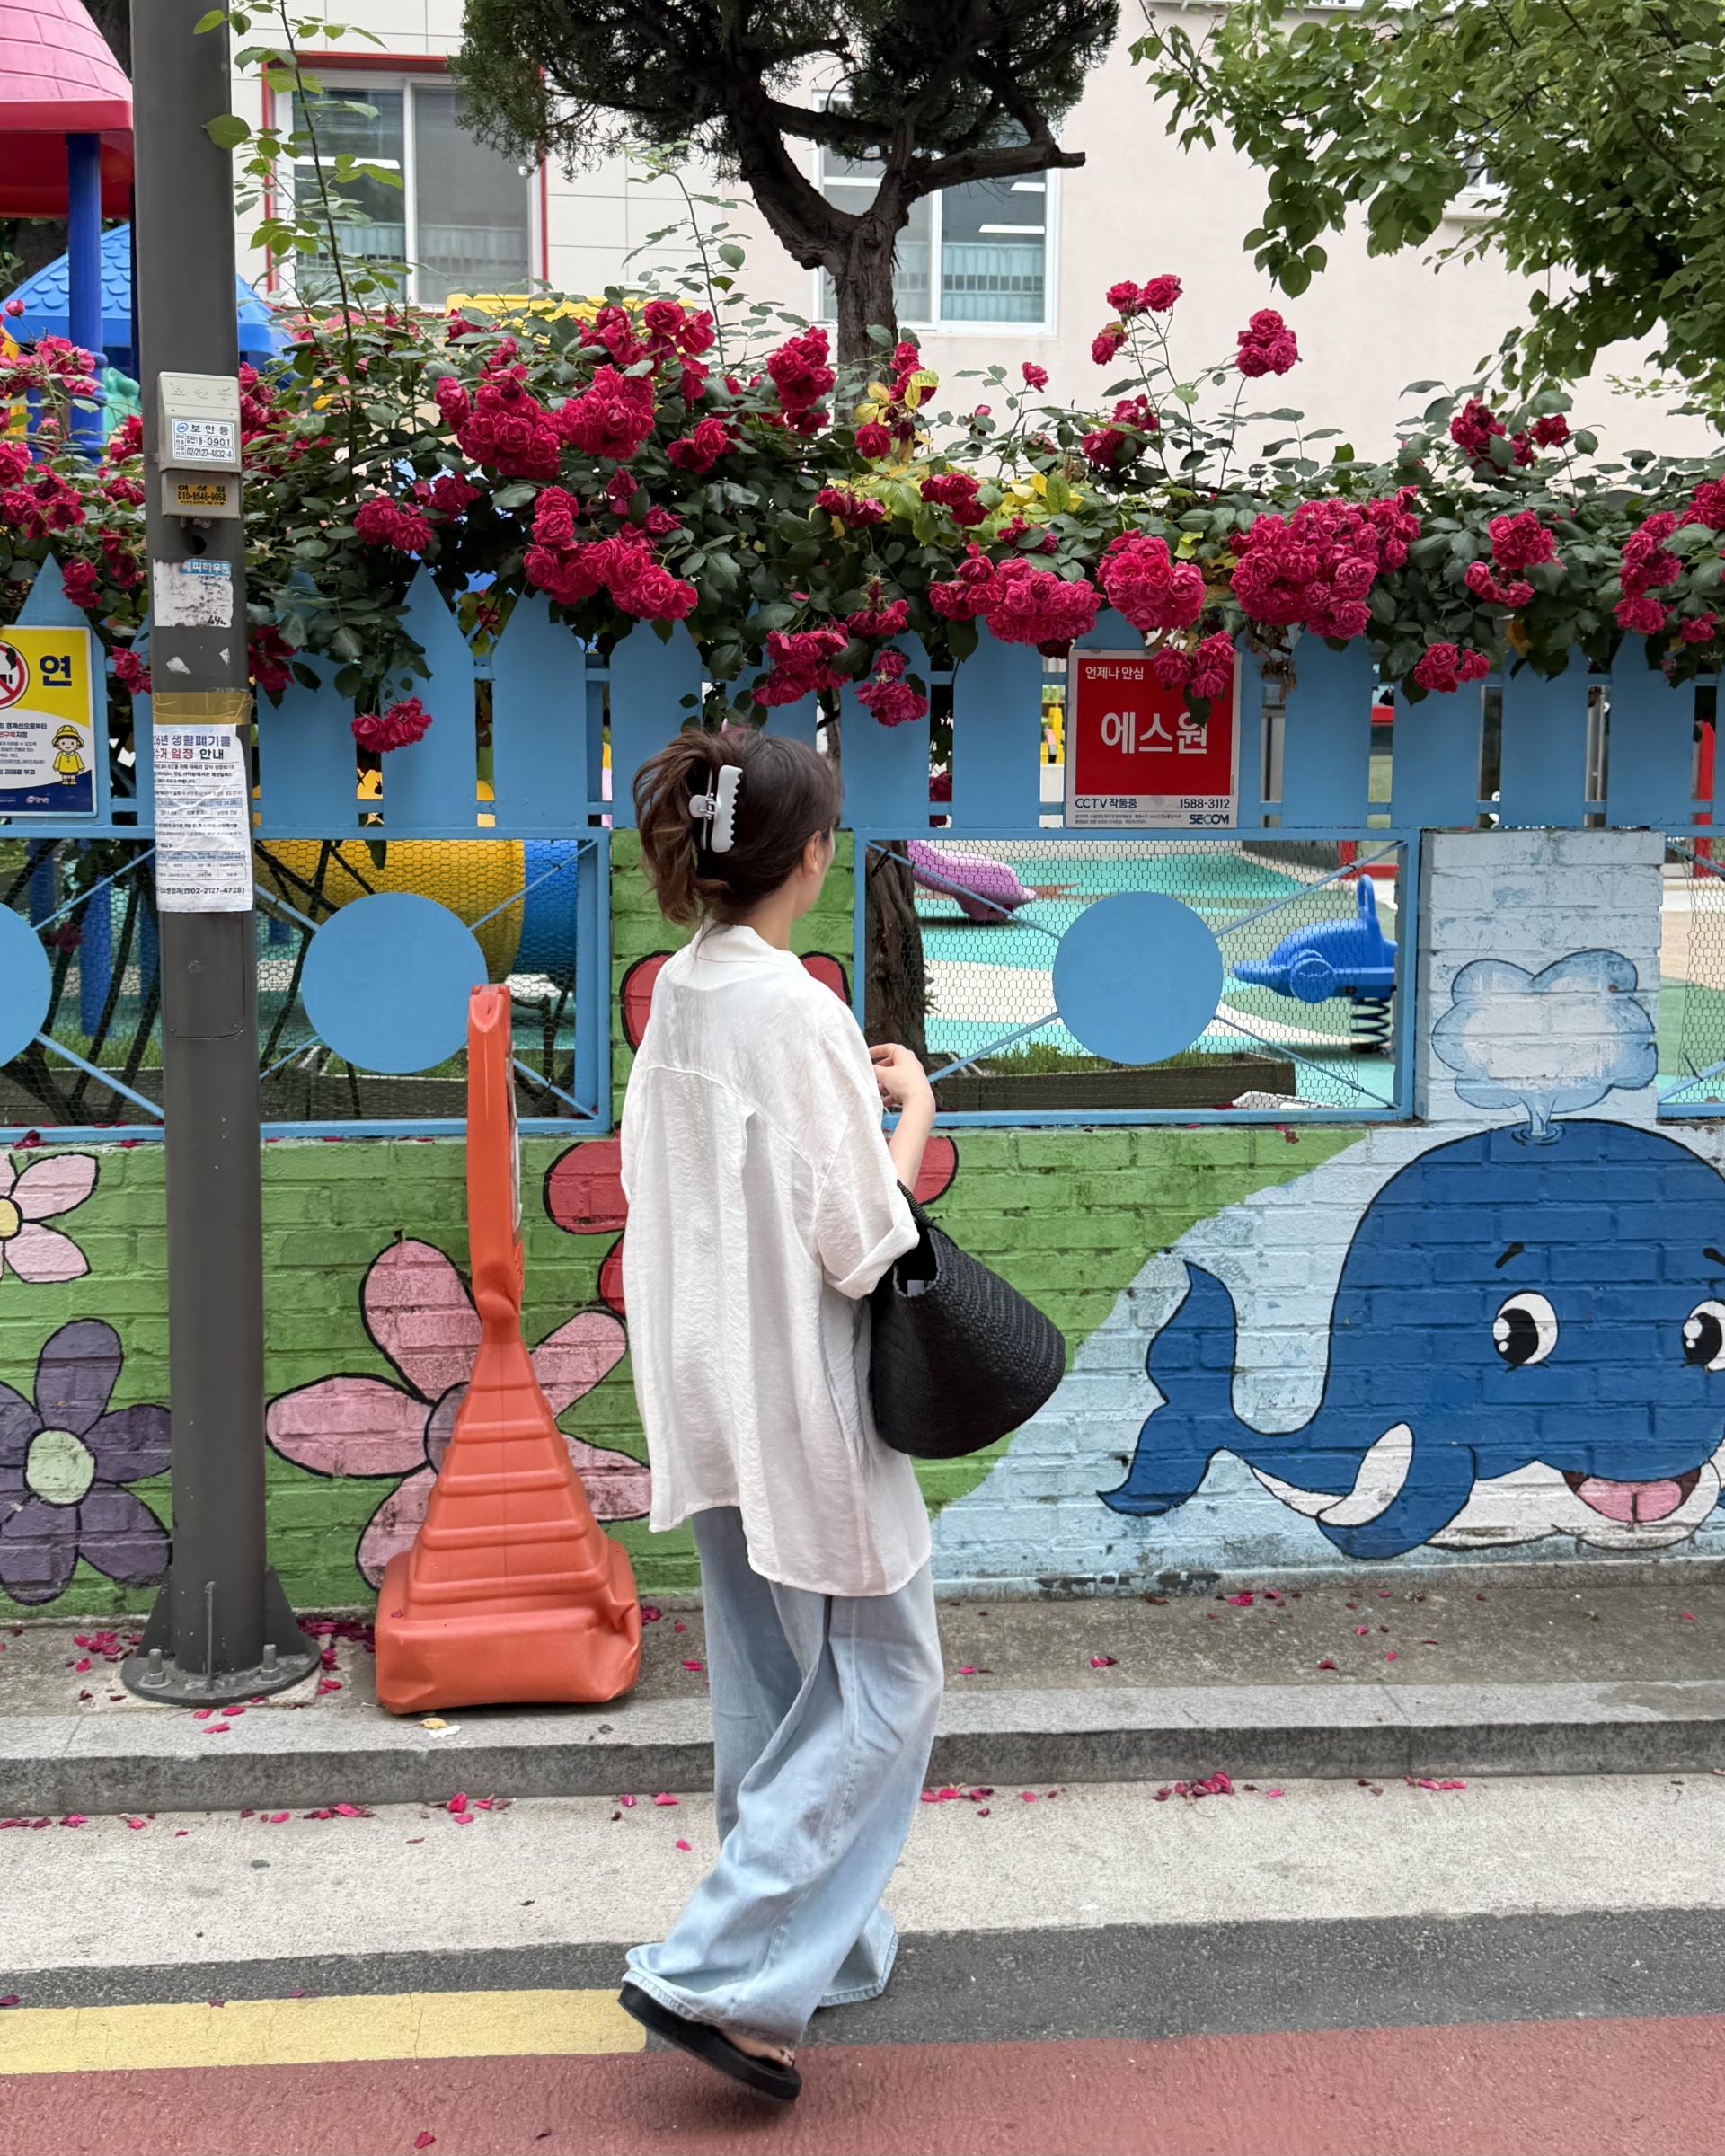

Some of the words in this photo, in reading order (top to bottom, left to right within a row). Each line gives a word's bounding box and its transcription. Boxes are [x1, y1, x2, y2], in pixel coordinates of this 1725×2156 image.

[190, 424, 229, 436] 보안등
[40, 655, 72, 686] 연
[1085, 666, 1120, 680] 언제나
[1121, 666, 1144, 680] 안심
[1101, 711, 1208, 755] 에스원
[172, 735, 231, 747] 생활폐기물
[172, 748, 194, 760] 일정
[199, 748, 224, 760] 안내
[1075, 798, 1107, 808] CCTV
[1109, 798, 1137, 808] 작동중
[1180, 798, 1230, 808] 1588-3112
[1189, 814, 1229, 825] SECOM
